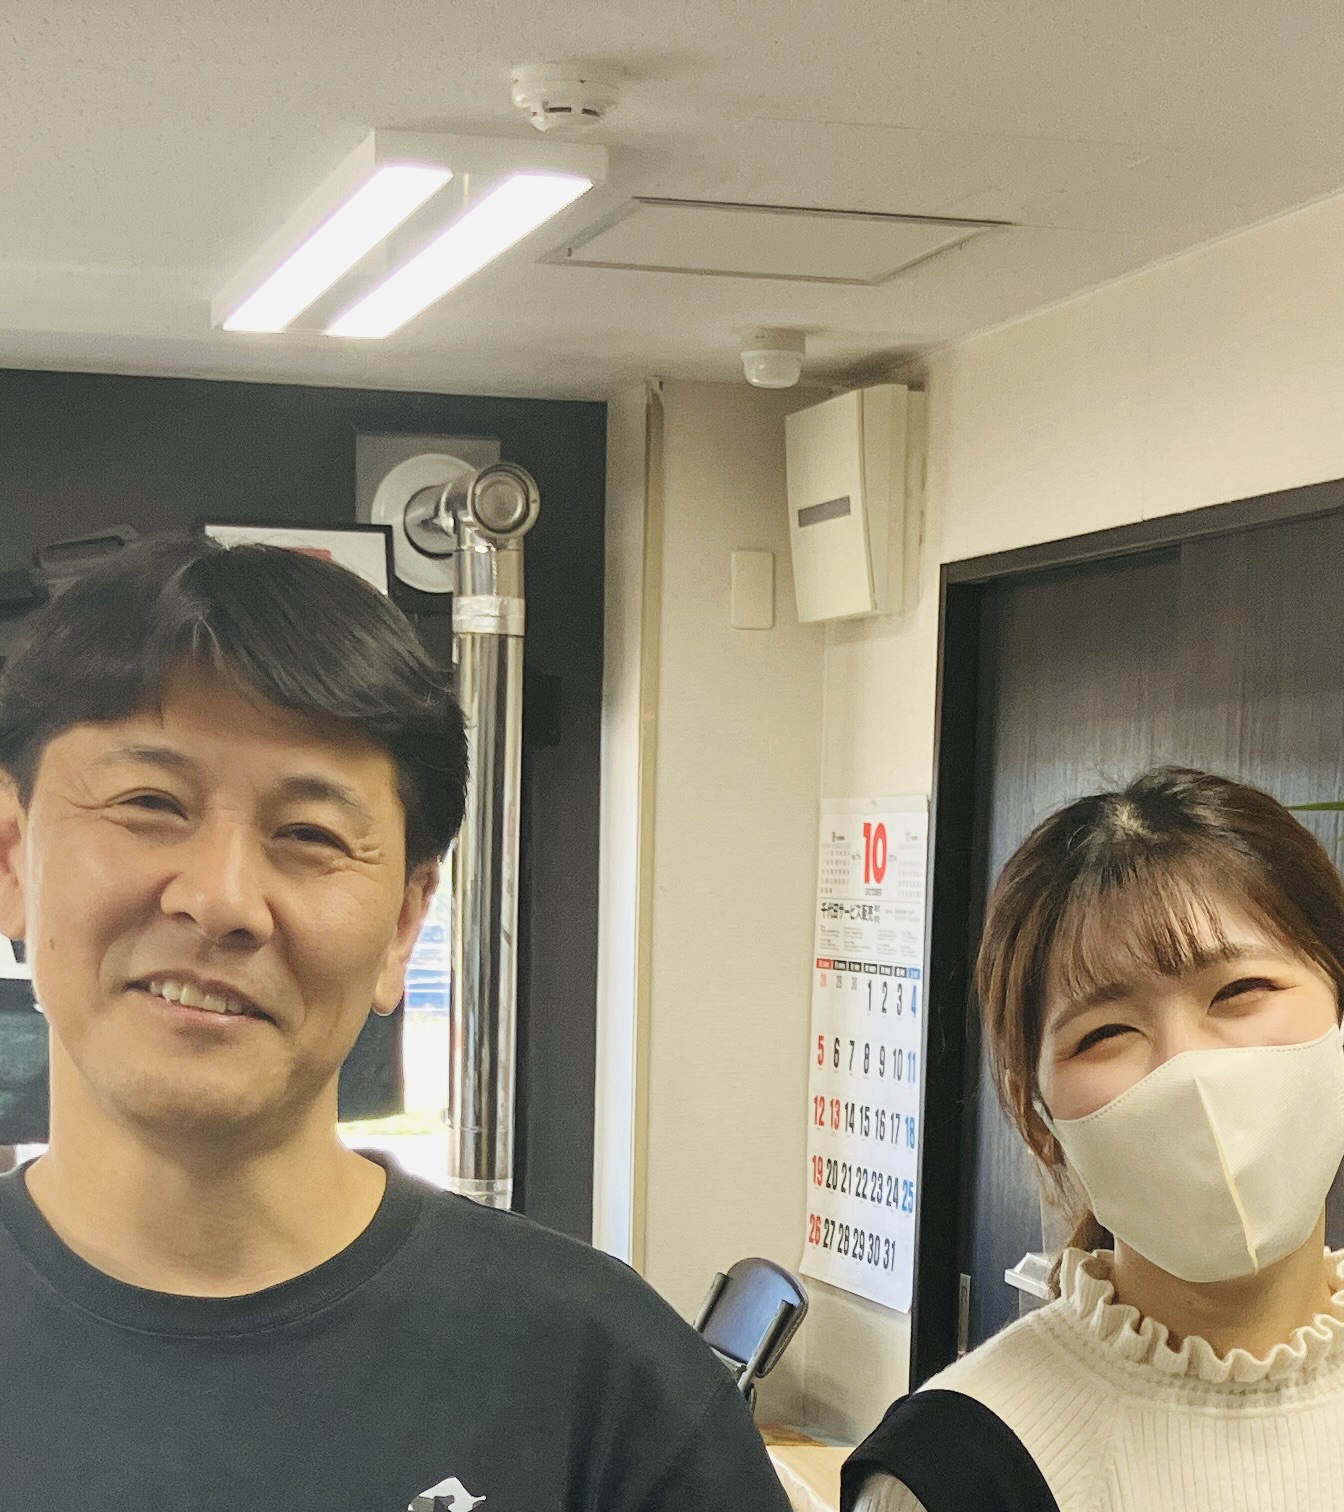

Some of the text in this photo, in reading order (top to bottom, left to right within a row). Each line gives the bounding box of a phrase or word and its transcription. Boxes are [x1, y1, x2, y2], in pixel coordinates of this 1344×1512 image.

[863, 822, 887, 884] 10
[867, 980, 872, 1011] 1
[881, 981, 888, 1013] 2
[896, 983, 903, 1016] 3
[911, 985, 917, 1018] 4
[817, 1035, 916, 1084] 5 6 7 8 9 10 11
[813, 1095, 916, 1149] 12 13 14 15 16 17 18
[812, 1155, 914, 1214] 19 20 21 22 23 24 25
[808, 1213, 896, 1272] 26 27 28 29 30 31
